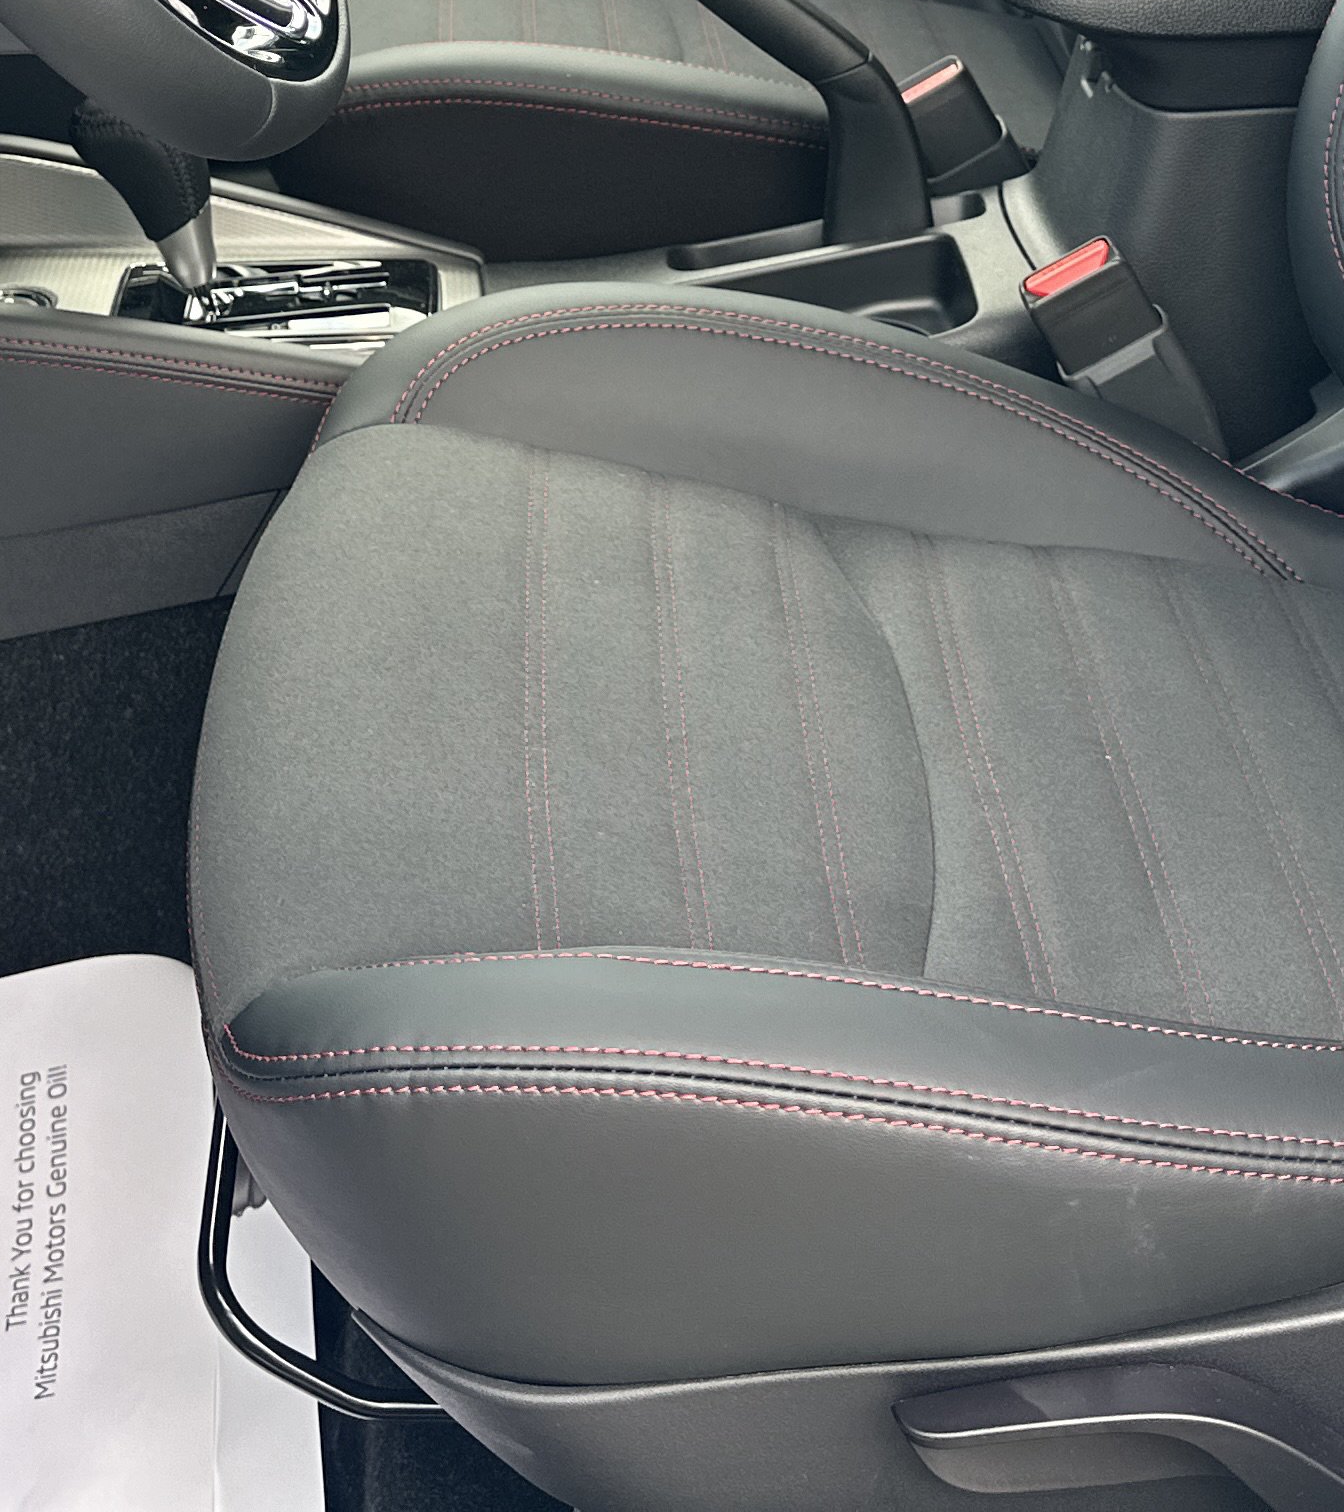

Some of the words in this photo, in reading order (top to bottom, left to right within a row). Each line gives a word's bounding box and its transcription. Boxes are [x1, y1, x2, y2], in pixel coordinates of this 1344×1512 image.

[48, 1065, 67, 1099] Oil!
[15, 1072, 41, 1173] choosing
[46, 1106, 67, 1197] Genuine
[12, 1181, 33, 1212] for
[11, 1219, 32, 1260] You
[44, 1204, 66, 1279] Motors
[5, 1264, 30, 1331] Thank
[34, 1289, 62, 1399] Mitsubishi
